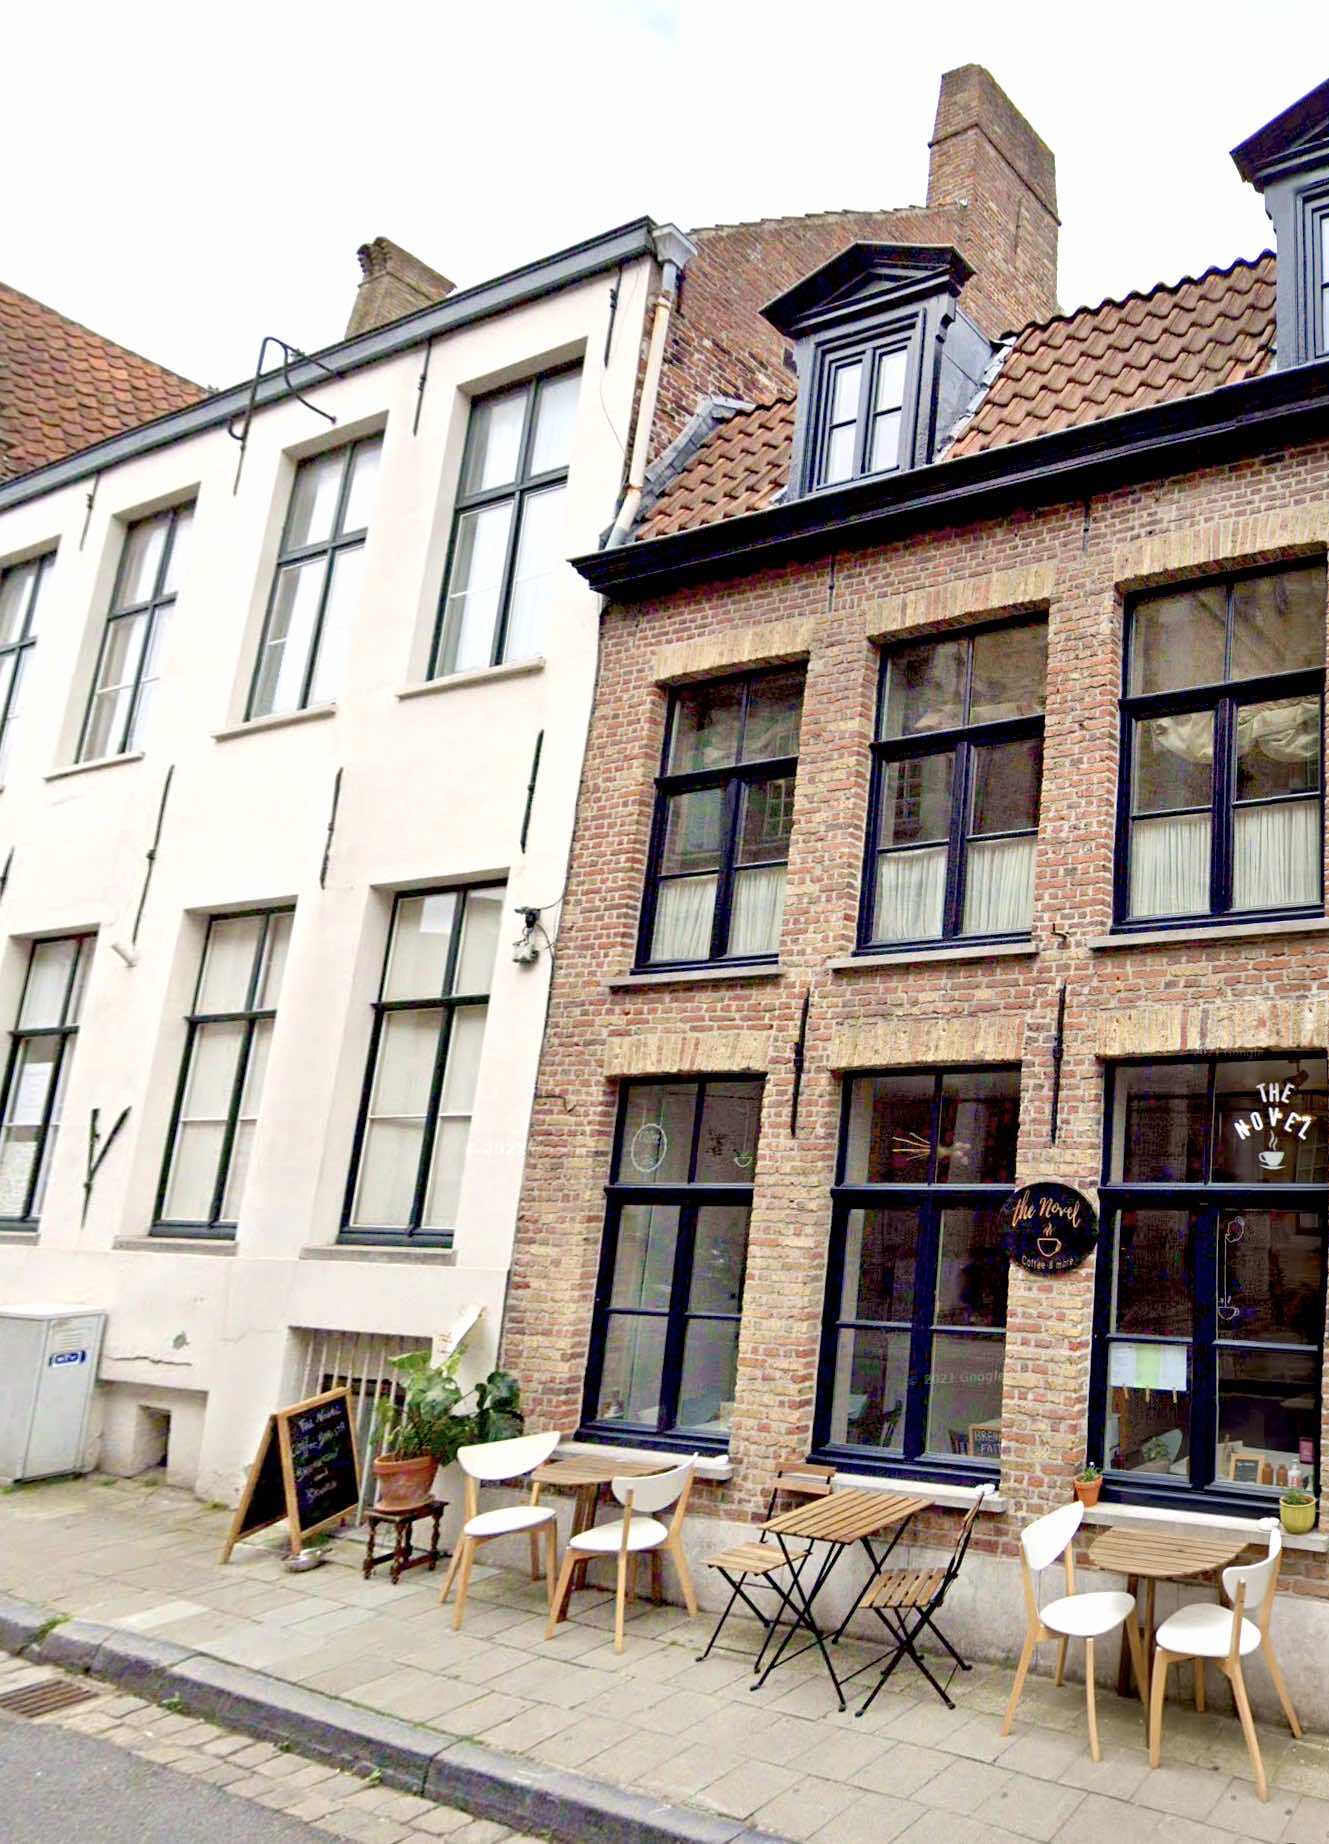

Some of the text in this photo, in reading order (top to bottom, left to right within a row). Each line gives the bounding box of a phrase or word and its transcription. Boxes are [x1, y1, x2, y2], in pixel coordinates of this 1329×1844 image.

[1256, 1082, 1295, 1104] THE
[1234, 1107, 1312, 1140] NOVEL
[1039, 1197, 1081, 1228] Novel
